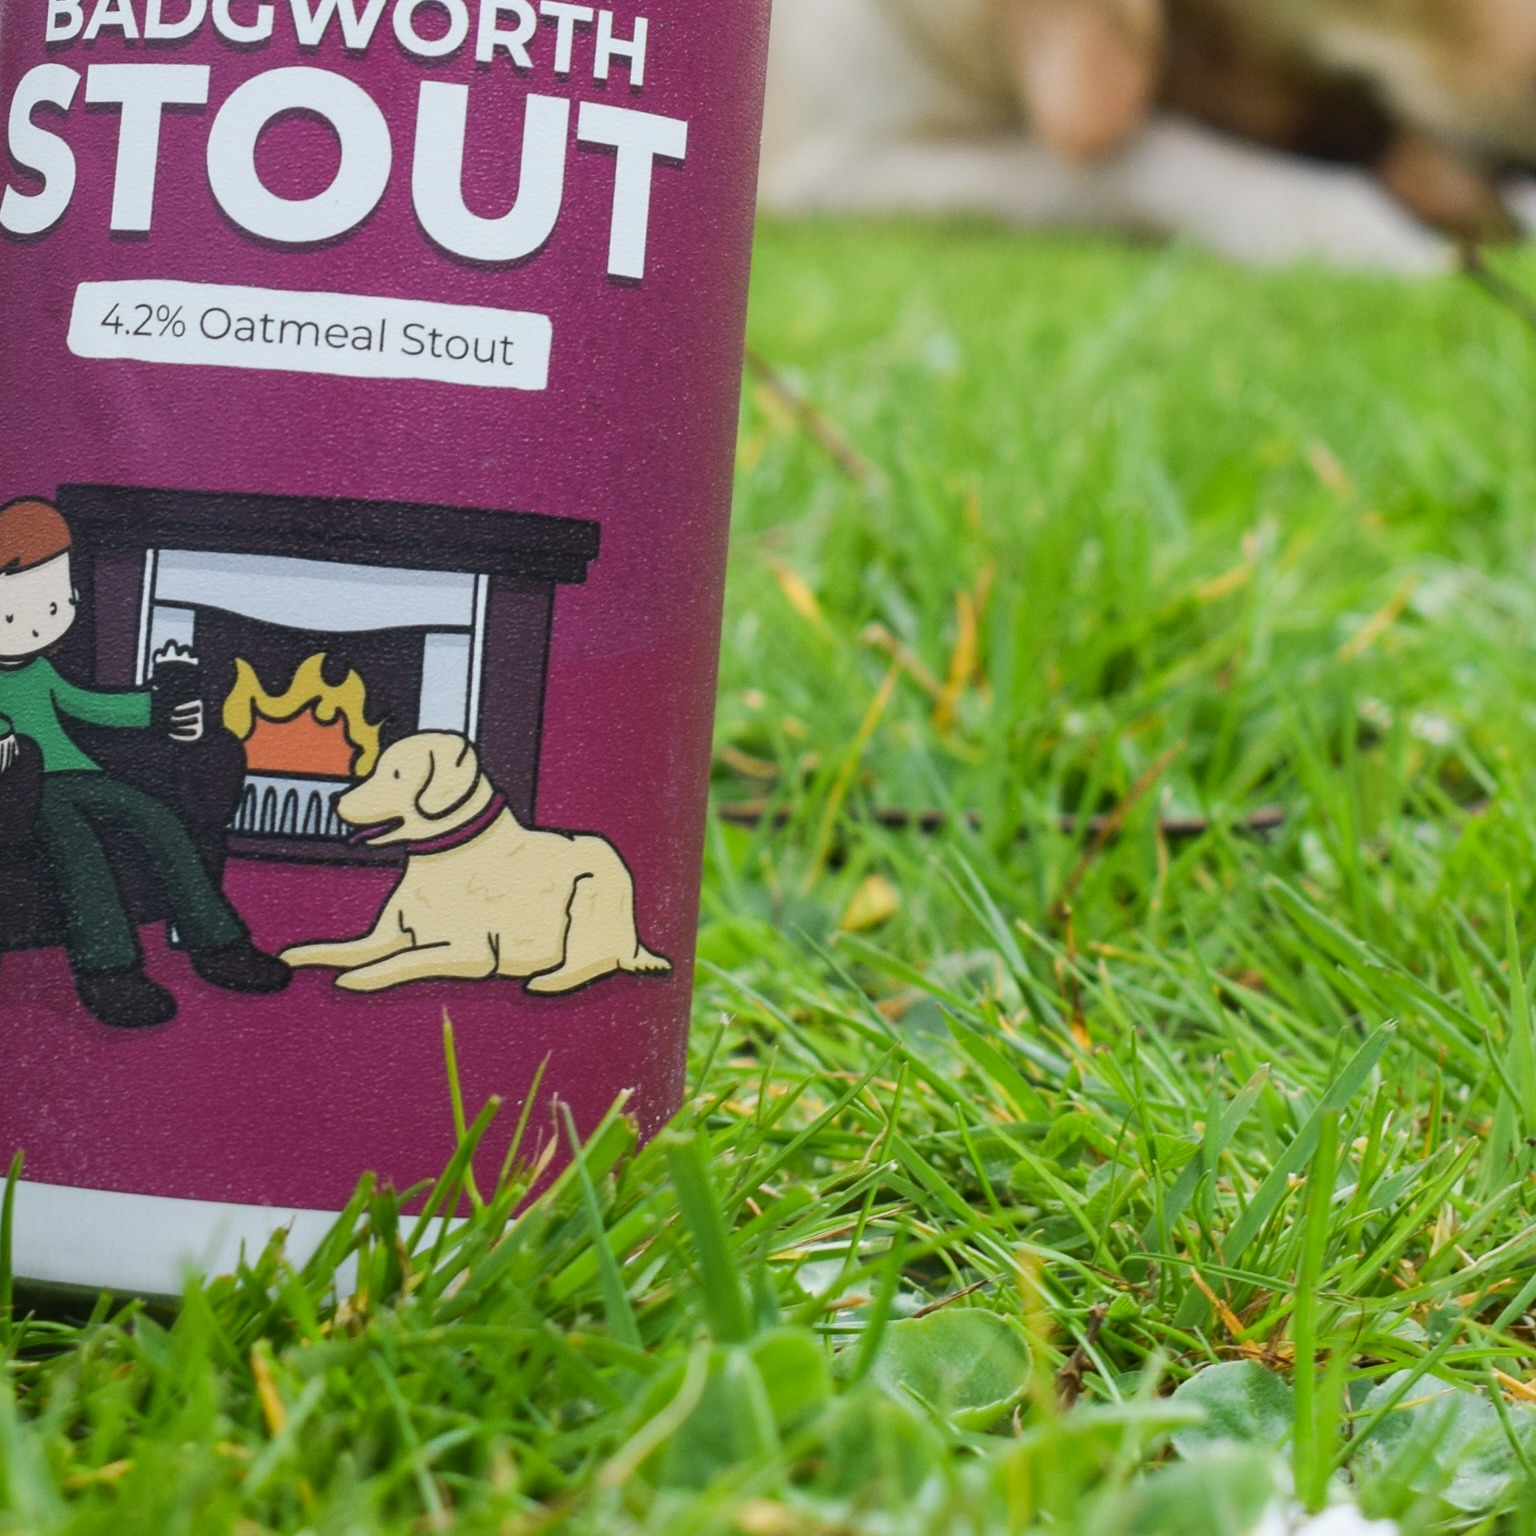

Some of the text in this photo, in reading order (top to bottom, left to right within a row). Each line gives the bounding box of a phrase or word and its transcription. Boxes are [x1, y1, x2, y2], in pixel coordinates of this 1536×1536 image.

[99, 301, 515, 366] 4.2% Oatmeal Stout
